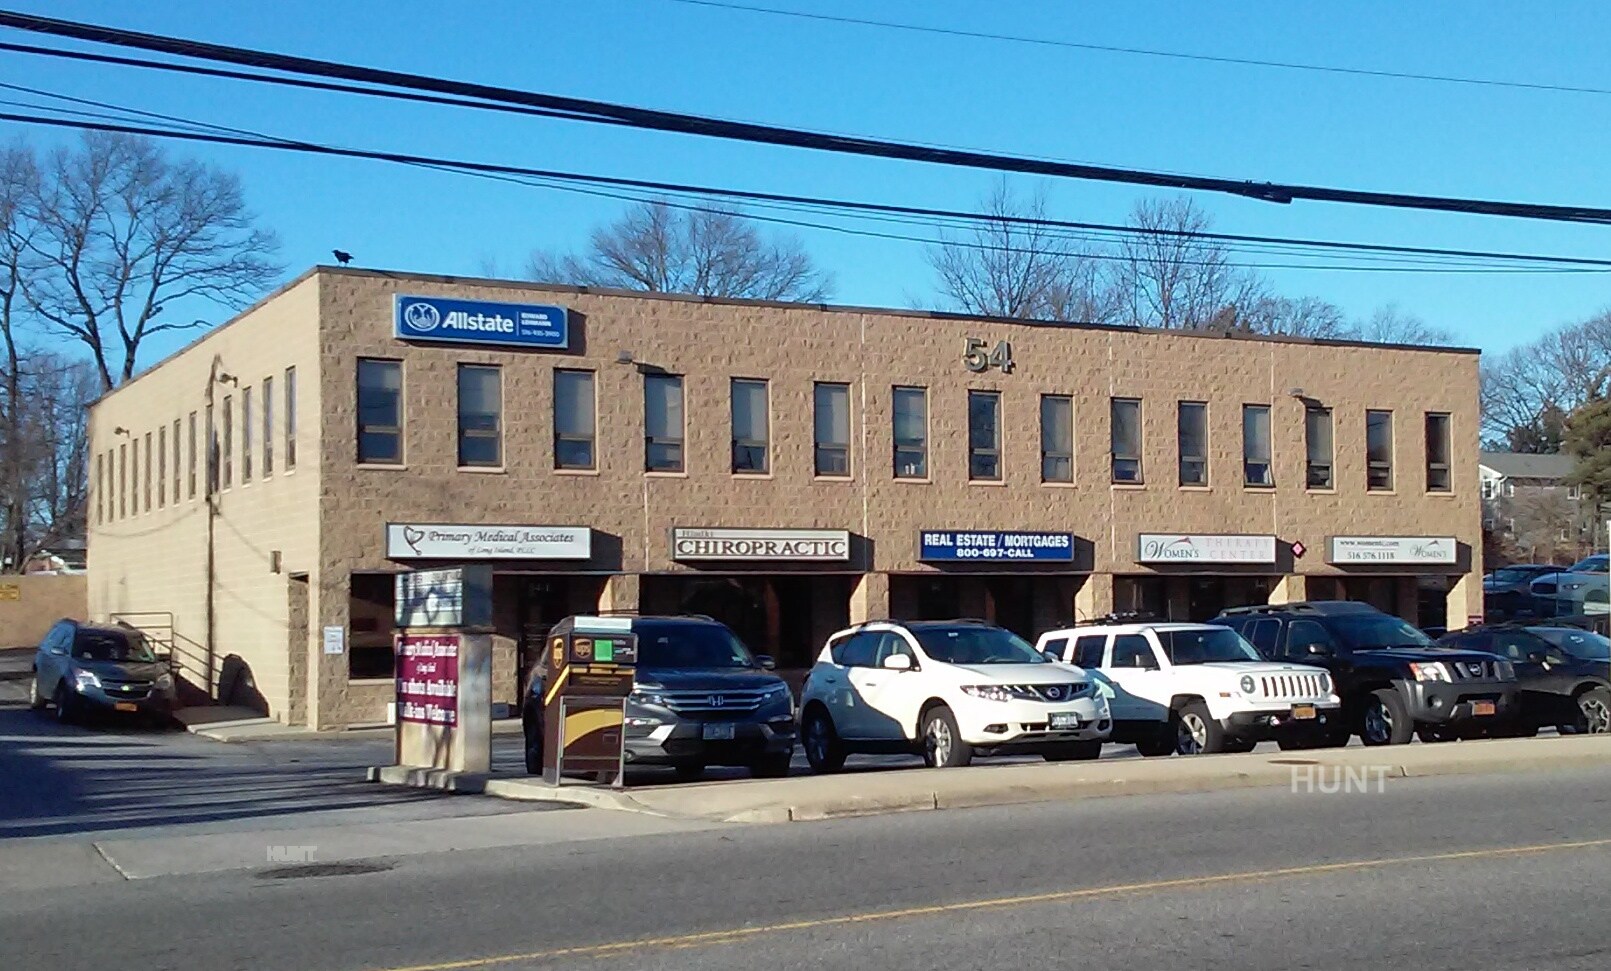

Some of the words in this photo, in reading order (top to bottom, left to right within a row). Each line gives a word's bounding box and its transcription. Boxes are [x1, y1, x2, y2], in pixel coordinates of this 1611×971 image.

[442, 311, 514, 333] Allstate
[963, 337, 1012, 373] 54
[428, 531, 472, 545] Primary
[474, 530, 518, 542] Medical
[520, 531, 574, 543] Associates
[924, 533, 953, 546] REAL
[956, 534, 996, 547] ESTATE
[1005, 535, 1069, 547] MORTGAGES
[677, 540, 846, 555] CHIROPRACTIC
[956, 548, 1034, 558] 800-697-CALL
[1209, 550, 1266, 559] CENTER
